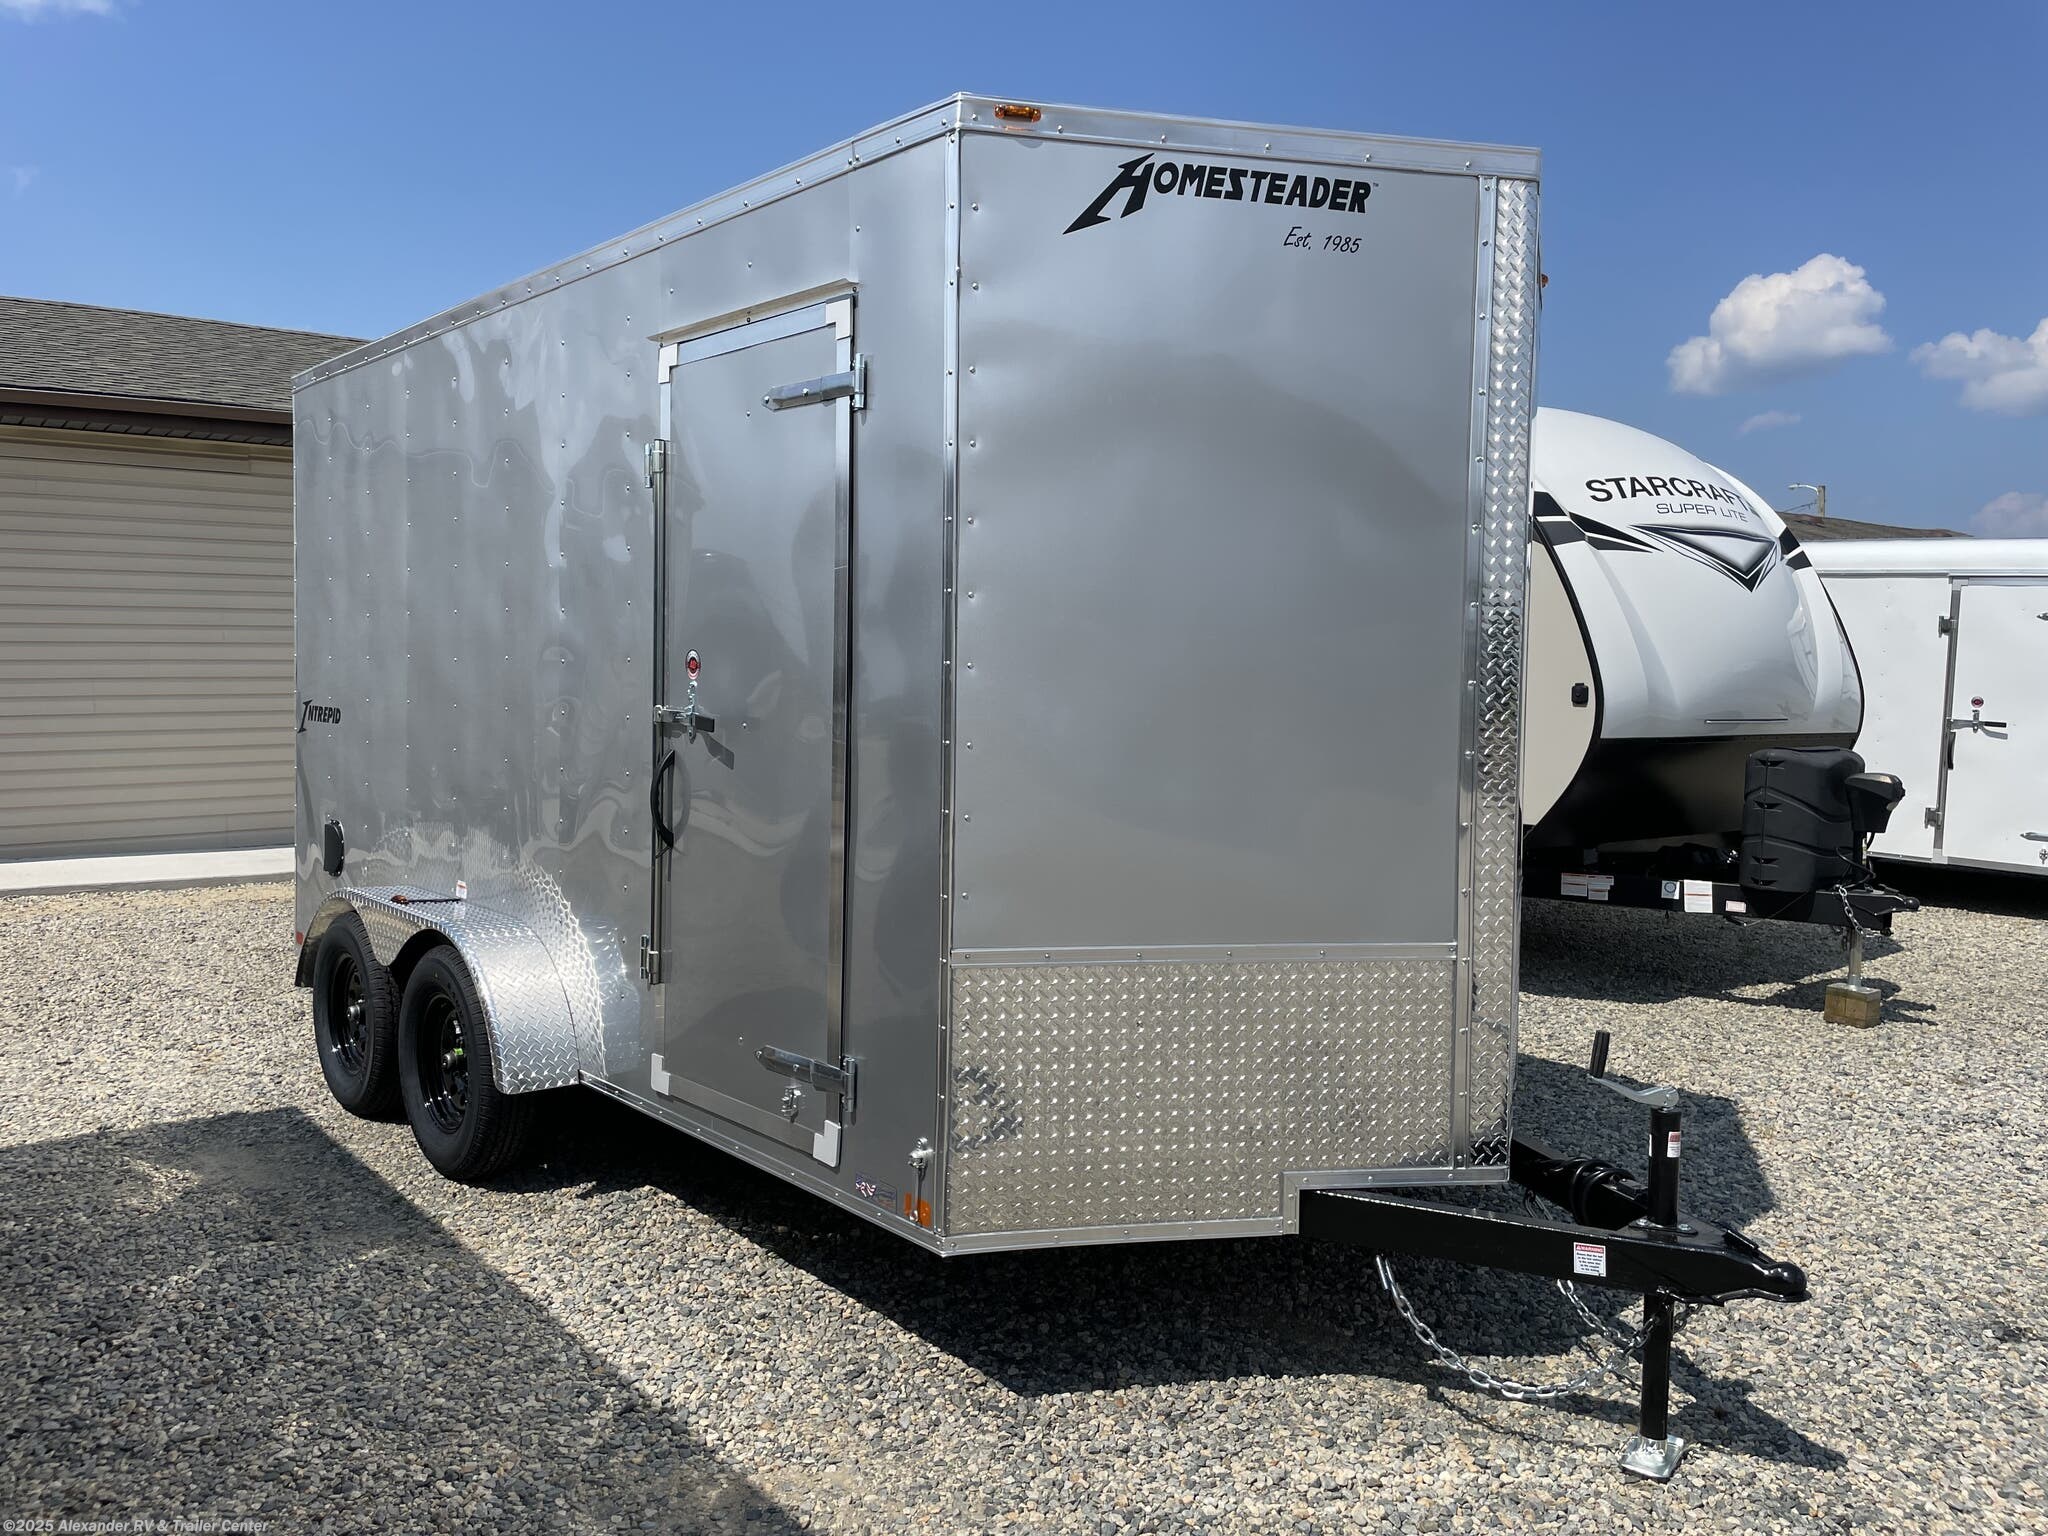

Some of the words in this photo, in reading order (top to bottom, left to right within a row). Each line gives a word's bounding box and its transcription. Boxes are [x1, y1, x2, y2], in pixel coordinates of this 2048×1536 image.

[1062, 153, 1372, 234] HOMESTEADER
[1283, 226, 1312, 250] Est.
[1323, 235, 1363, 254] 1985
[1585, 476, 1749, 512] STARCRAFT
[1656, 503, 1717, 516] SUPER
[1720, 507, 1749, 523] LITE
[297, 699, 342, 734] INTREPID
